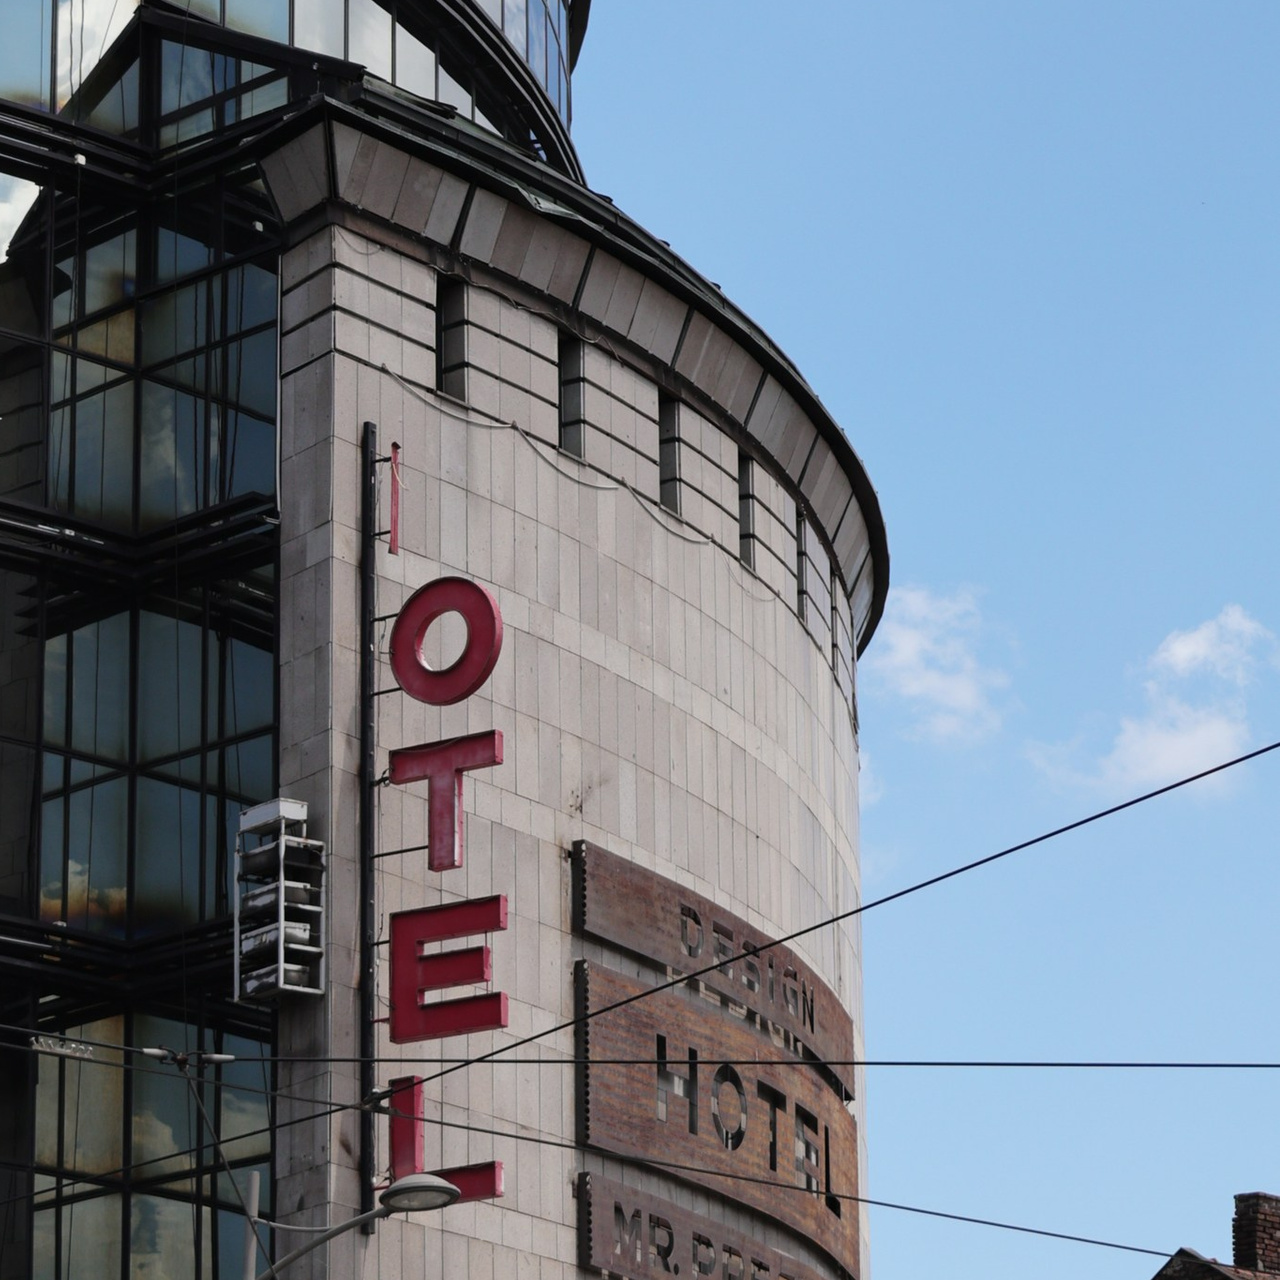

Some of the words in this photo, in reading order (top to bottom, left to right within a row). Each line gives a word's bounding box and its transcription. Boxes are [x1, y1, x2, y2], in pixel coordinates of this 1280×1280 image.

[389, 442, 509, 1204] OTEL
[679, 902, 818, 1035] DESIGN
[655, 1032, 842, 1220] HOTEL
[613, 1201, 682, 1276] MR.
